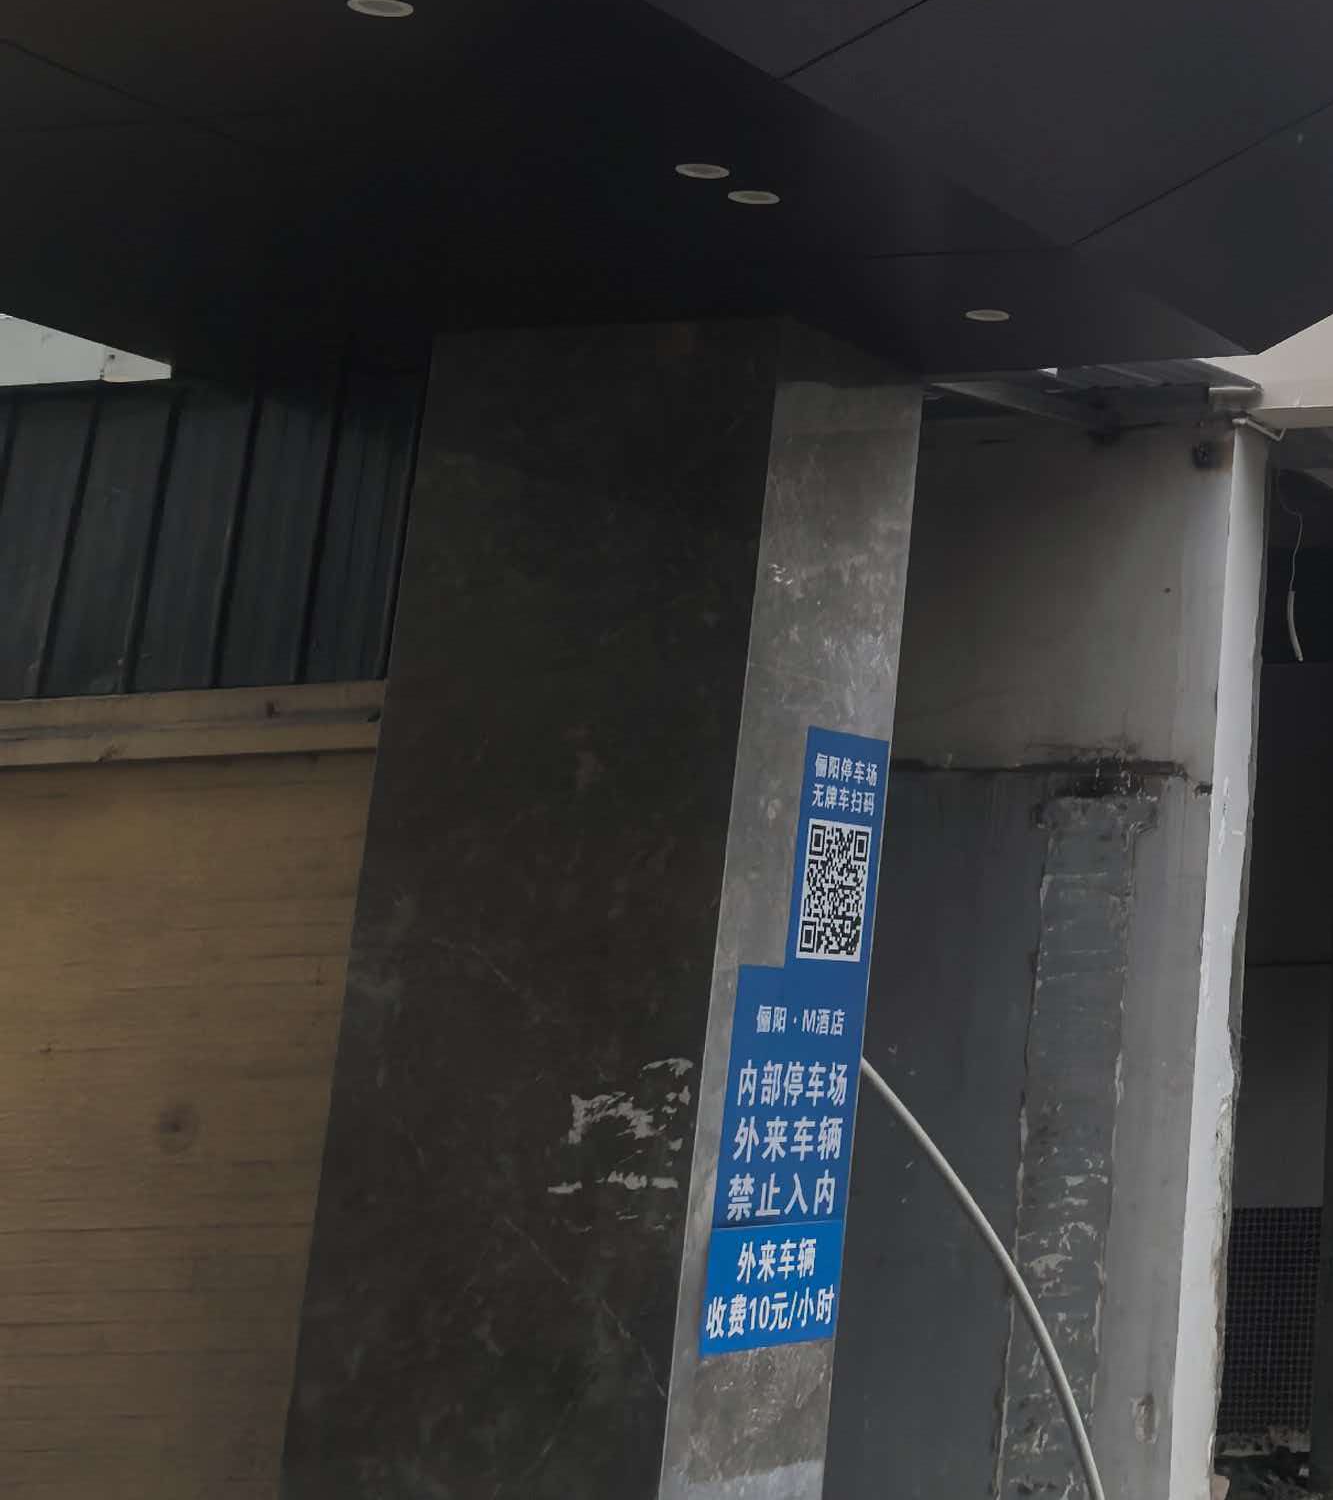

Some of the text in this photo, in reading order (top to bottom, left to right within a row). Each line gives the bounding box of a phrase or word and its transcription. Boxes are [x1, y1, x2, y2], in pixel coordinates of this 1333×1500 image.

[815, 752, 878, 787] 俪阳停车场
[811, 783, 875, 816] 无牌车扫码
[737, 1059, 848, 1107] 内部停车场
[732, 1115, 844, 1163] 外来车辆
[726, 1169, 836, 1221] 禁止入内
[736, 1237, 816, 1284] 外来车辆
[706, 1284, 834, 1340] 收费10元/小时
